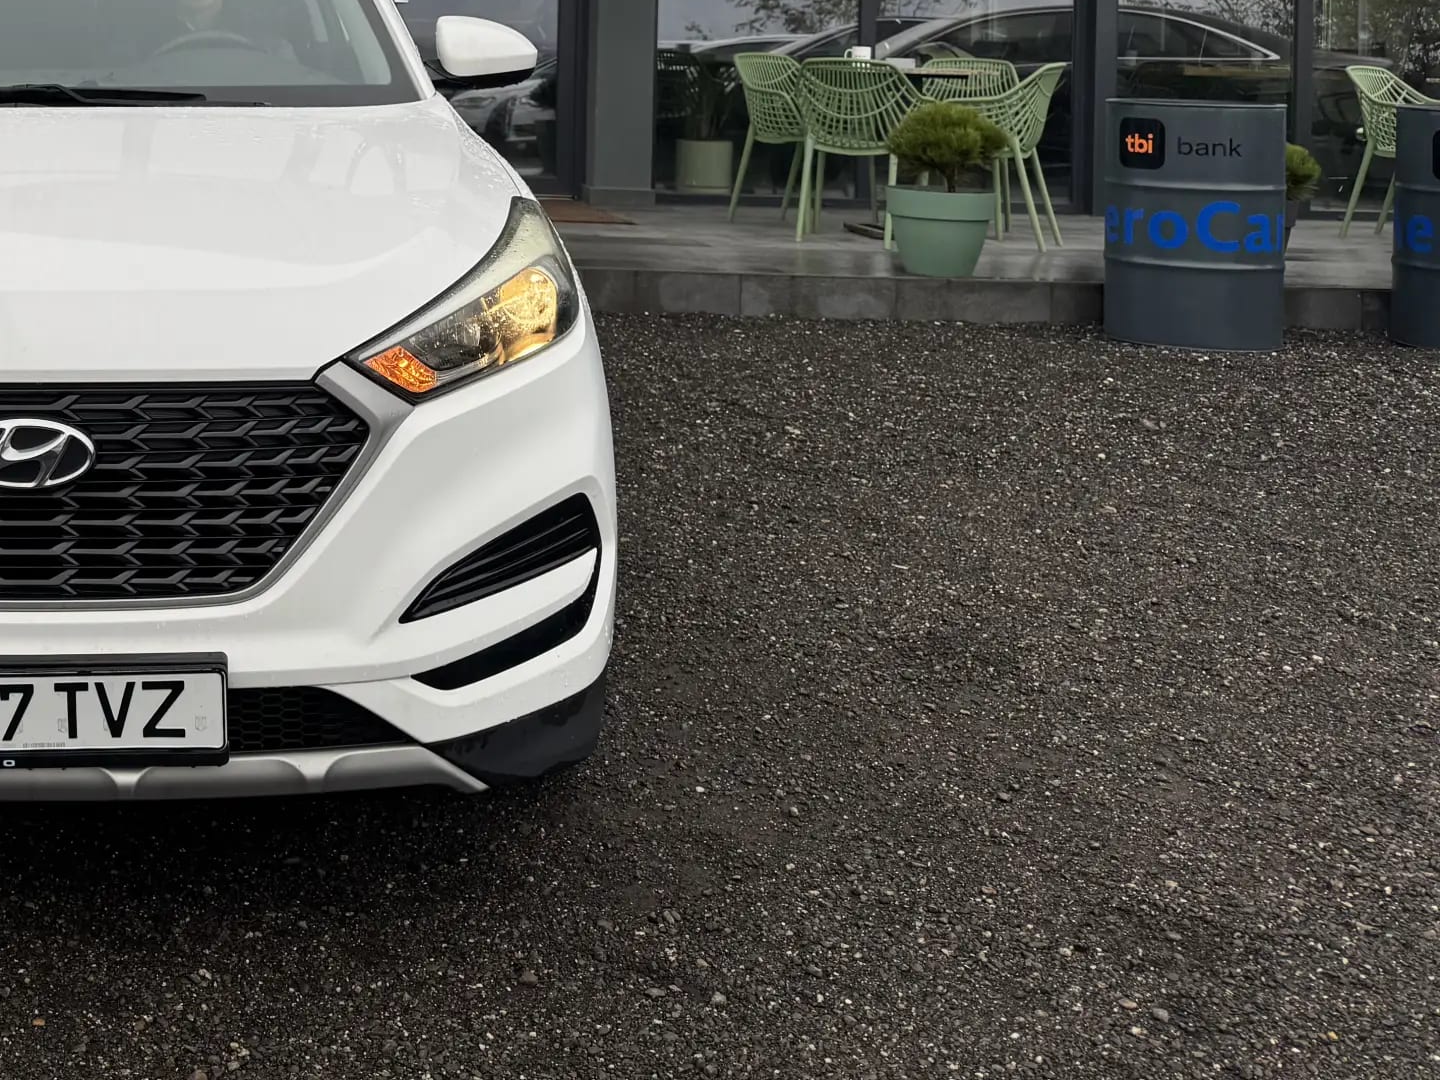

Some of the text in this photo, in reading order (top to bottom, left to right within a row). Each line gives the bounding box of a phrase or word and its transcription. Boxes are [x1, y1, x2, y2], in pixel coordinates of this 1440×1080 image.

[1125, 133, 1243, 158] tbi bank
[54, 680, 187, 738] TVZ
